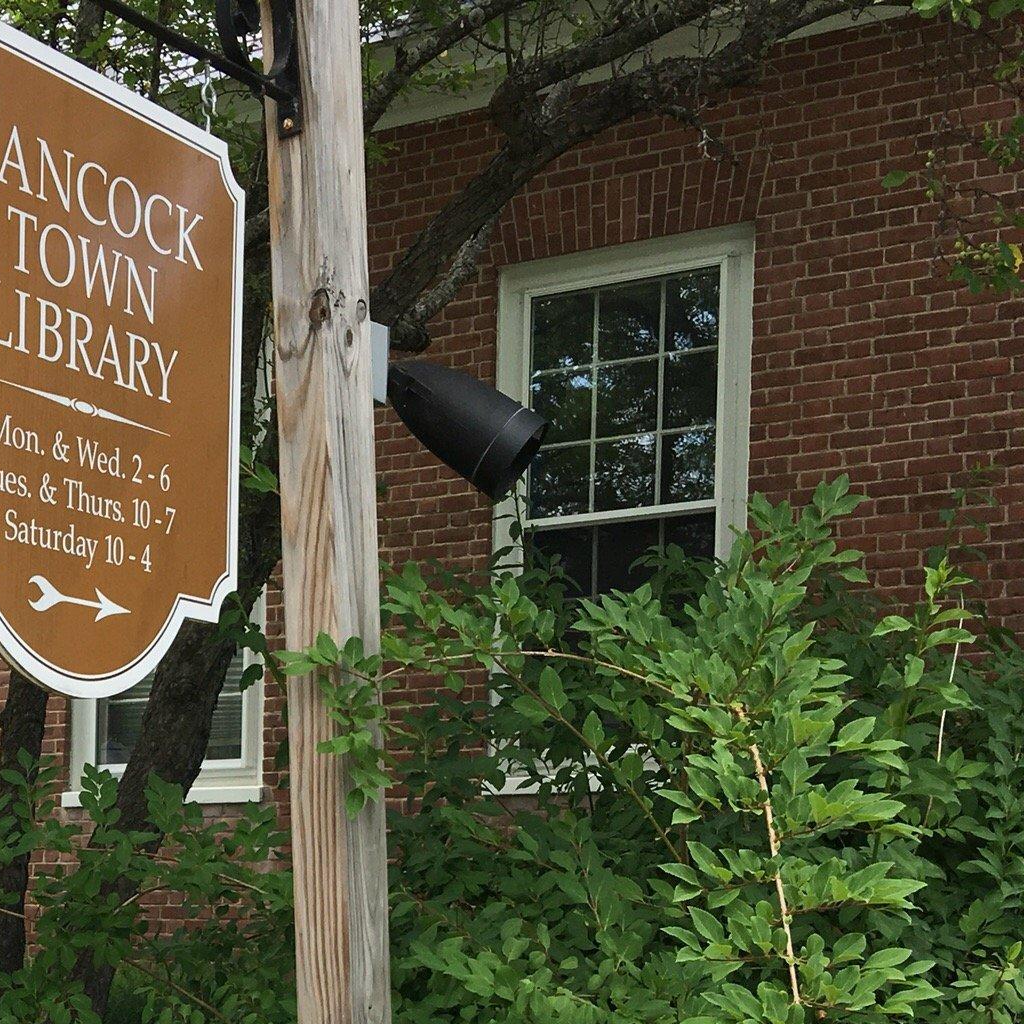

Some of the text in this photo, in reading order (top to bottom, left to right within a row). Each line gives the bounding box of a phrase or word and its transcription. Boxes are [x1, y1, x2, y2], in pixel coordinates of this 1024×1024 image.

[7, 205, 159, 325] TOWN
[52, 430, 70, 463] &
[76, 435, 126, 479] Wed.
[131, 454, 143, 485] 2
[159, 463, 171, 492] 6
[39, 472, 58, 505] &
[63, 477, 125, 523] Thurs.
[132, 498, 151, 530] 10
[165, 506, 177, 535] 7
[4, 508, 99, 570] Saturday
[104, 534, 124, 566] 10
[140, 544, 152, 573] 4
